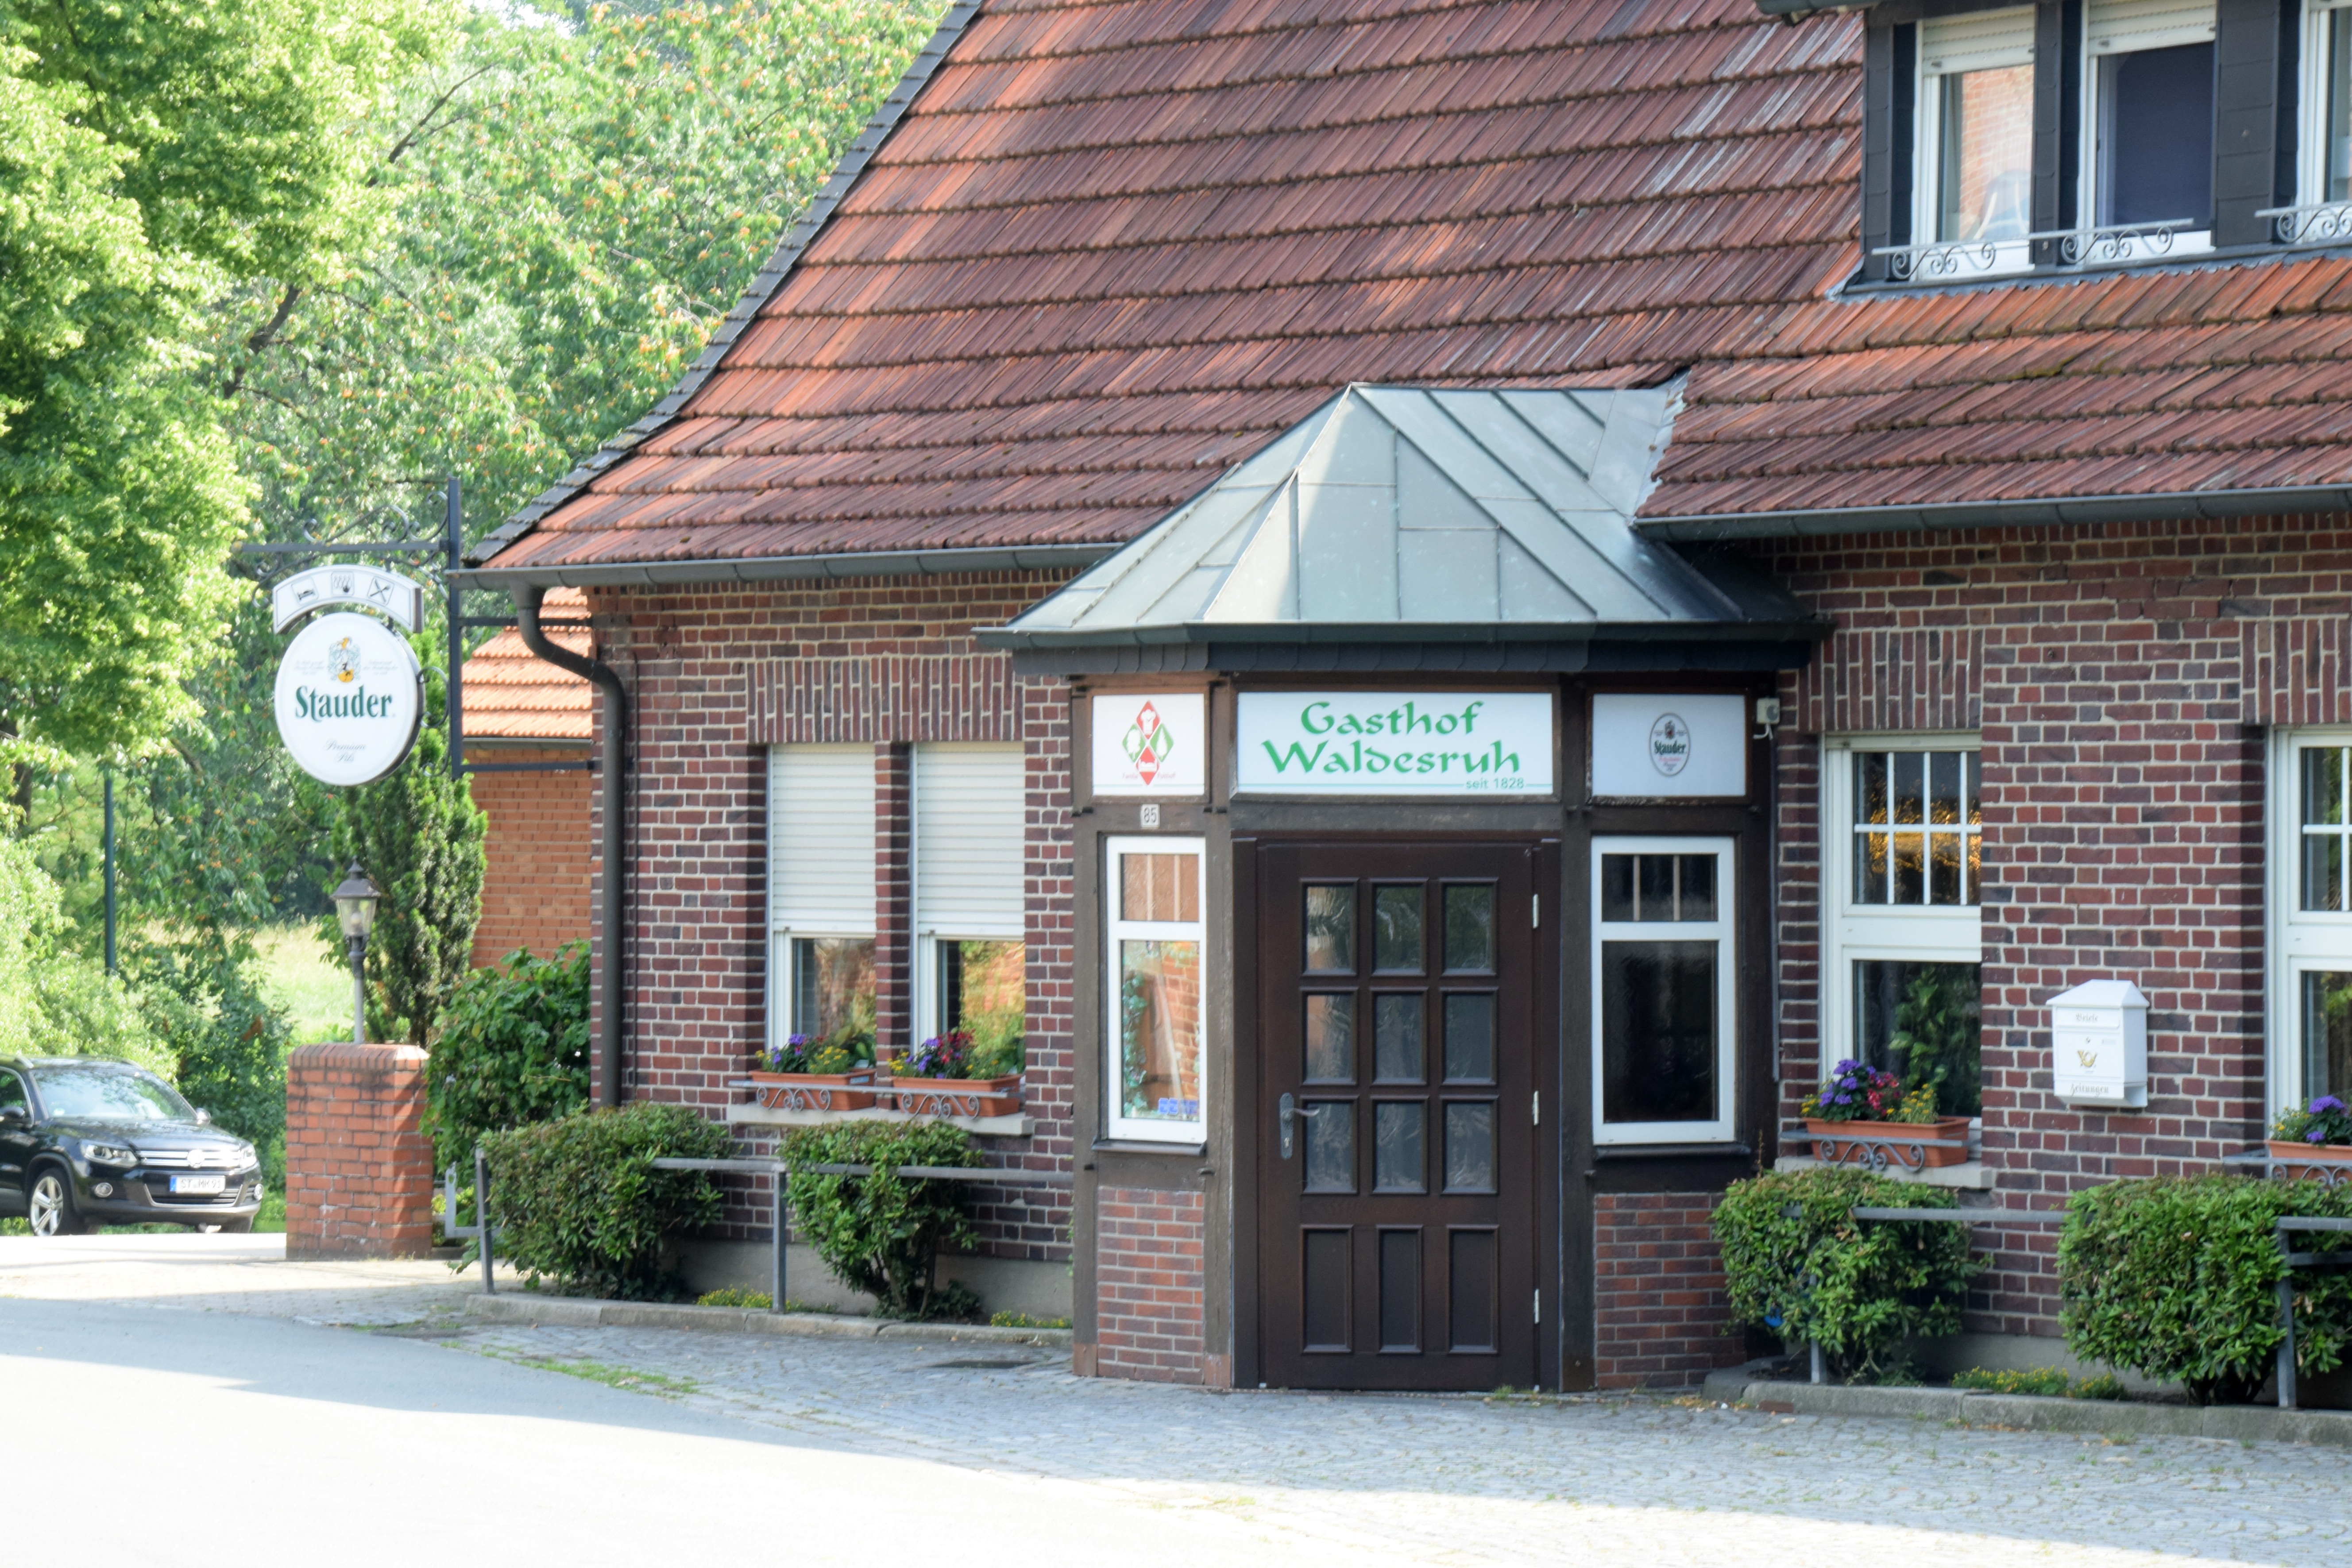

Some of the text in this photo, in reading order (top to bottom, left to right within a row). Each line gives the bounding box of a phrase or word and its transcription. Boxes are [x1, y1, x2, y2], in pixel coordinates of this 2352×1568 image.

[295, 685, 392, 722] Stauder
[1300, 700, 1484, 735] Gasthof
[323, 739, 367, 750] Premium
[1654, 740, 1686, 755] Stauder
[1261, 739, 1520, 774] Waldesruh
[1466, 777, 1524, 790] seit 1828
[1143, 807, 1157, 823] 85
[2075, 1013, 2098, 1021] Briefe
[2070, 1082, 2109, 1097] Zeitungen
